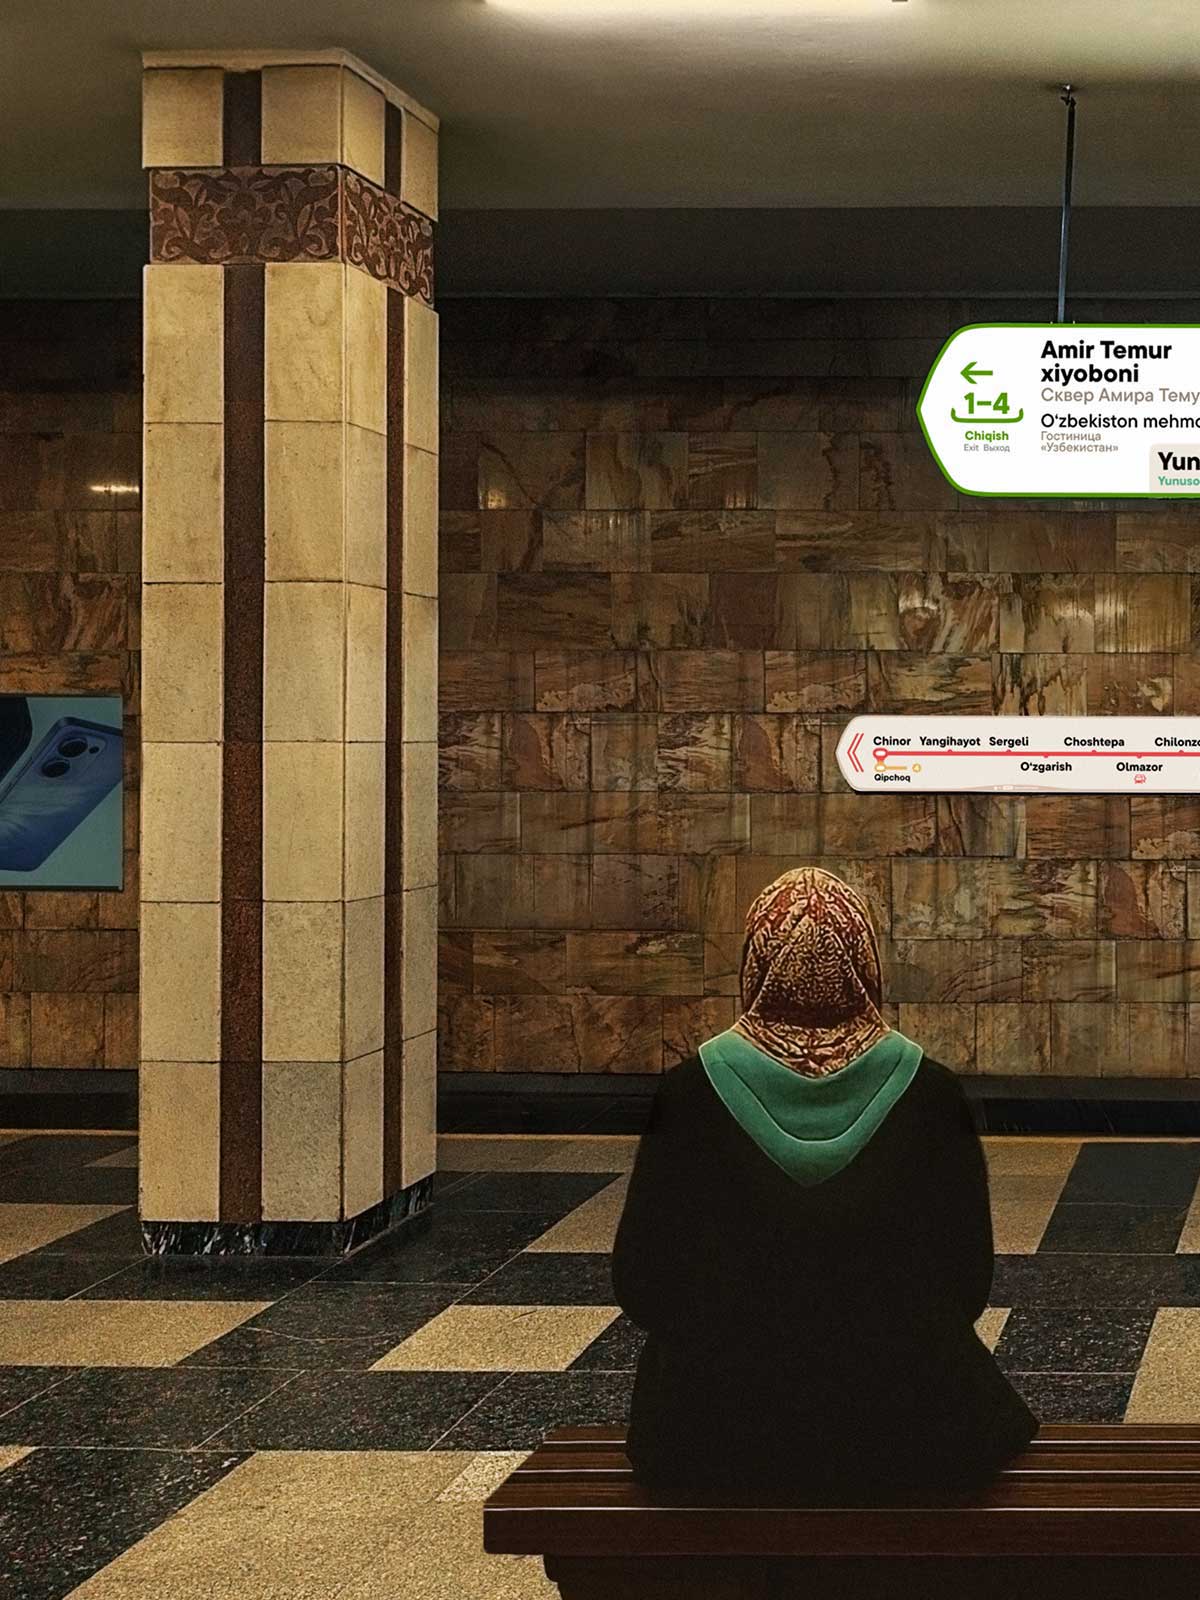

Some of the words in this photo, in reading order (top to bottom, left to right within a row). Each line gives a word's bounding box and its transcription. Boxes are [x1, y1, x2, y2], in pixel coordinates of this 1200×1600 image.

[1041, 340, 1094, 358] Amir
[1100, 341, 1172, 359] Temur
[1041, 363, 1138, 386] xiyoboni
[1041, 386, 1094, 405] Сквер
[1099, 388, 1153, 405] Амира
[965, 431, 1008, 442] Chiqish
[1041, 431, 1101, 442] Гостиница
[964, 444, 980, 452] Exit
[984, 444, 1010, 452] Выход
[1041, 442, 1118, 452] «Узбекистан»
[873, 736, 911, 745] Chinor
[920, 736, 980, 748] Yangihayot
[989, 737, 1028, 748] Sergeli
[1064, 737, 1124, 748] Choshtepa
[1116, 762, 1163, 771] Olmazor
[874, 774, 910, 782] Qipchoq
